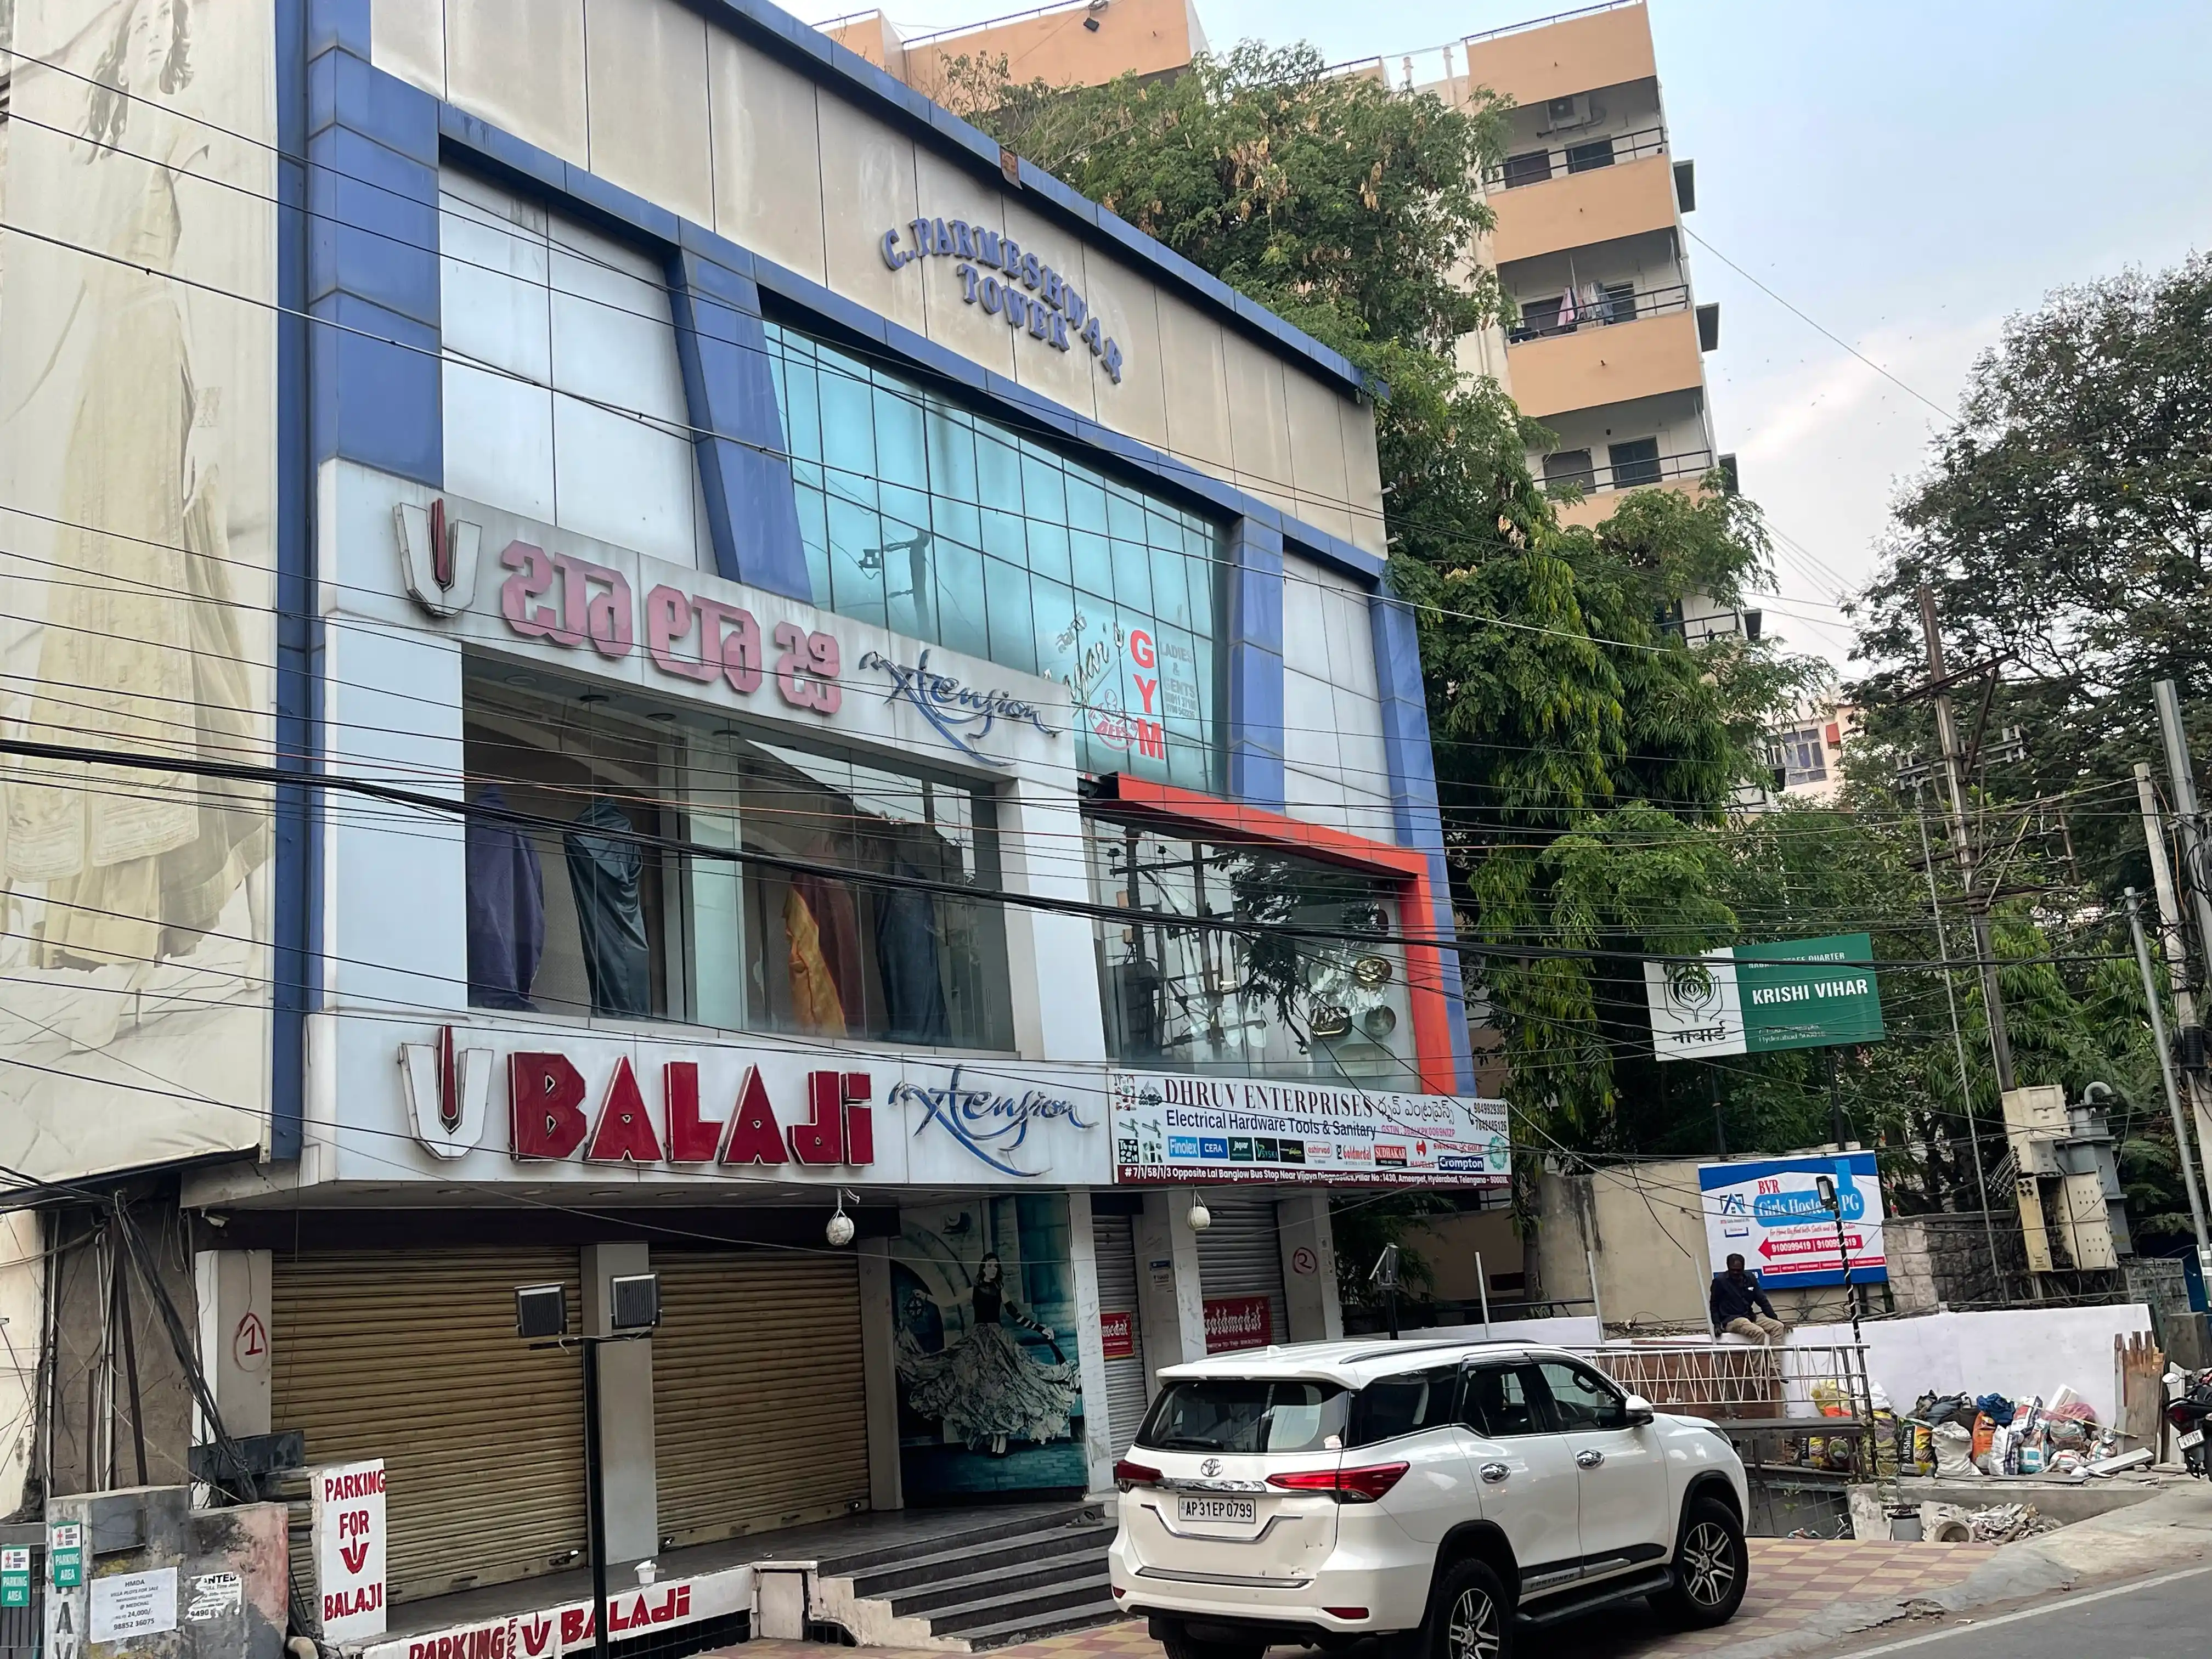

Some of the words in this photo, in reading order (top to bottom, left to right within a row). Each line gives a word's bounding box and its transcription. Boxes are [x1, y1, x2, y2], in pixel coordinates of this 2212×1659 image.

[957, 263, 1070, 352] TOWER
[1160, 641, 1193, 664] LADIES
[1130, 629, 1164, 760] GYM
[1163, 676, 1195, 698] GENTS
[1752, 985, 1809, 1005] KRISHI
[1816, 979, 1868, 998] VIHAR
[1164, 1079, 1237, 1108] DHRUV
[1244, 1085, 1373, 1118] ENTERPRISES
[1166, 1109, 1226, 1129] Electrical
[1229, 1113, 1285, 1132] Hardware
[1289, 1118, 1320, 1135] Tools
[1323, 1120, 1330, 1135] &
[1333, 1120, 1376, 1141] Sanitary
[1170, 1138, 1198, 1154] Finolex
[1204, 1143, 1223, 1153] CERA
[1343, 1145, 1372, 1160] Goldmedal
[1439, 1157, 1483, 1169] Crompton
[1133, 1165, 1171, 1179] 7/1/58/1/3
[1172, 1167, 1207, 1180] Opposite
[1207, 1168, 1218, 1178] Lal
[1219, 1169, 1249, 1181] Banglow
[1250, 1170, 1263, 1178] Bus
[1263, 1170, 1279, 1181] Stop
[1280, 1170, 1296, 1180] Near
[1758, 1179, 1780, 1194] BVR
[1759, 1200, 1787, 1217] Girls
[1788, 1198, 1827, 1215] Hoste
[1841, 1193, 1860, 1211] PG
[325, 1469, 386, 1502] PARKING
[340, 1510, 369, 1539] FOR
[55, 1553, 79, 1566] PARKING
[3, 1576, 27, 1587] PARKING
[60, 1569, 75, 1581] AREA
[125, 1579, 145, 1587] HMDA
[7, 1590, 22, 1601] AREA
[324, 1582, 382, 1622] BALAJI
[114, 1622, 133, 1630] 98852
[136, 1618, 155, 1628] 36075
[410, 1627, 505, 1659] PARKING
